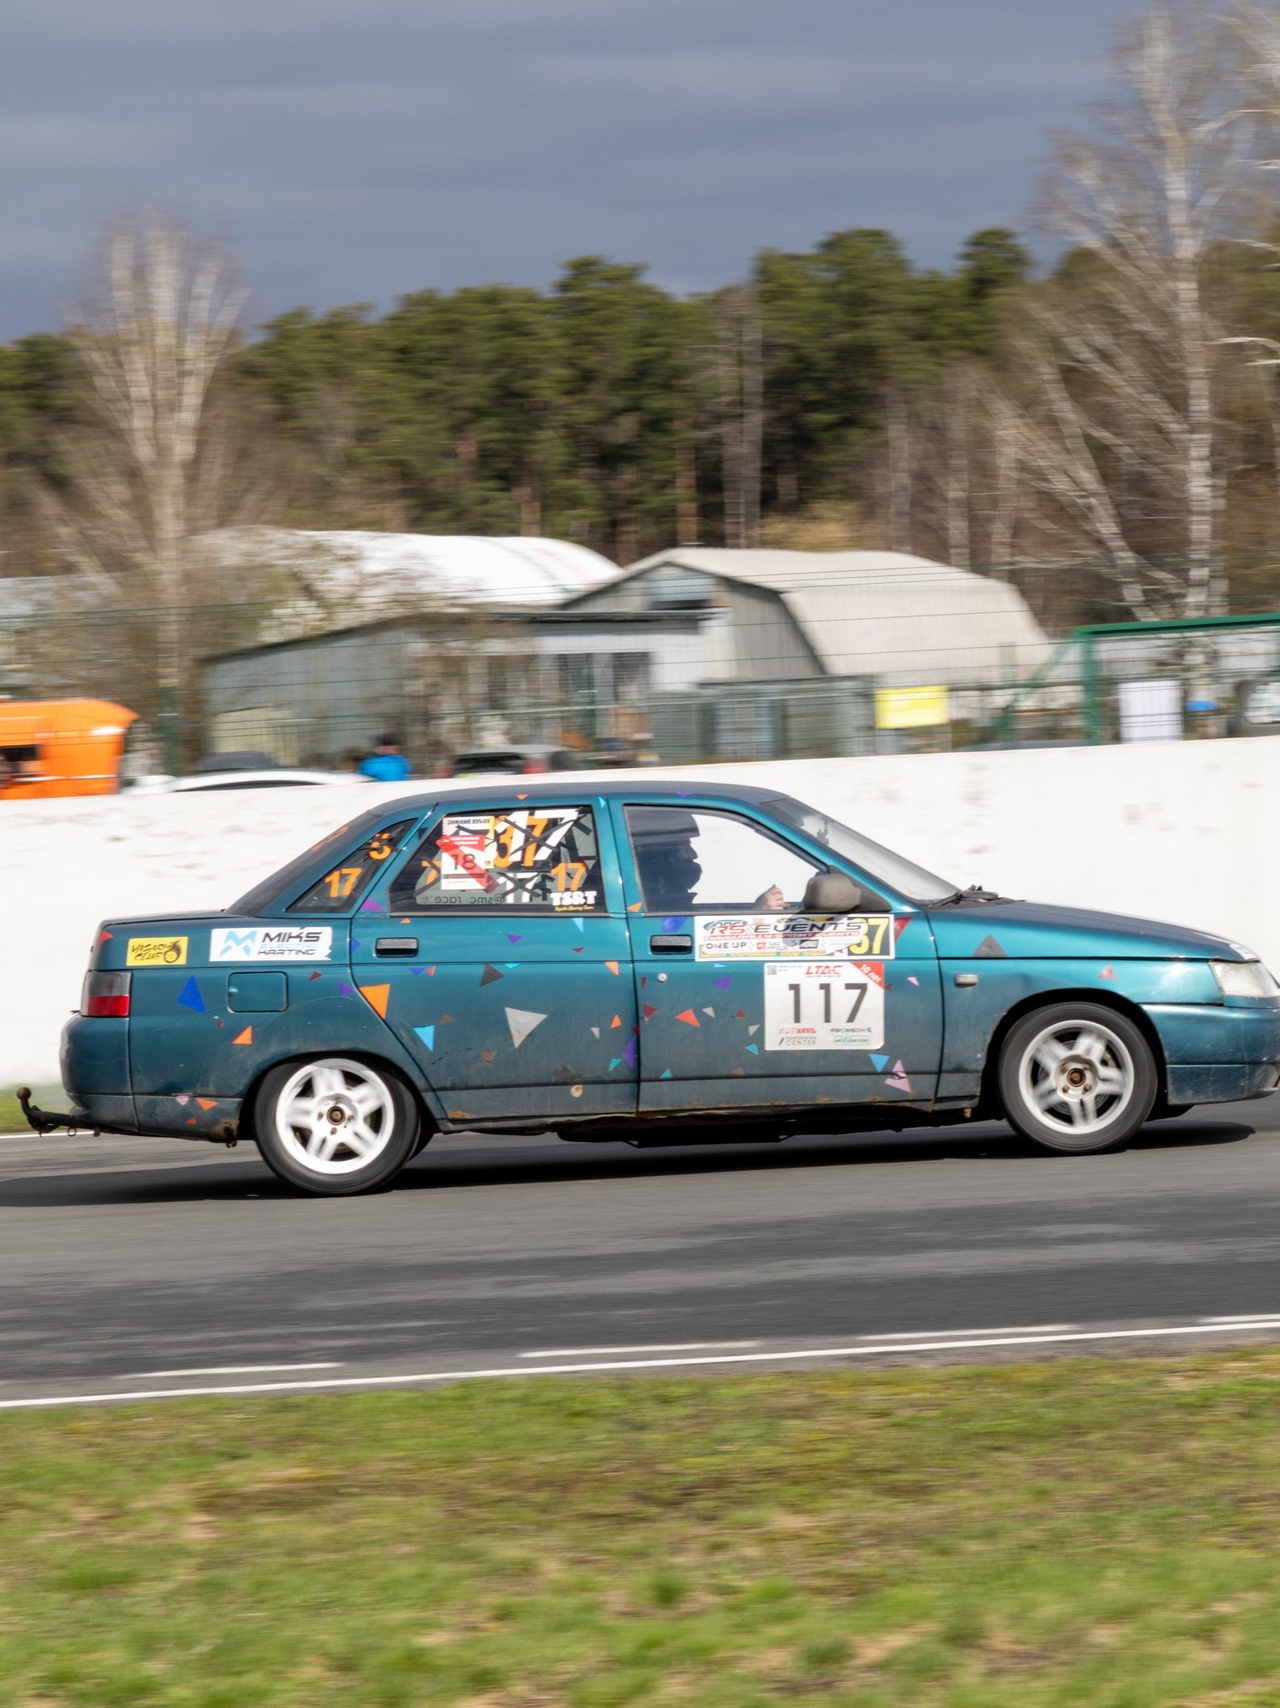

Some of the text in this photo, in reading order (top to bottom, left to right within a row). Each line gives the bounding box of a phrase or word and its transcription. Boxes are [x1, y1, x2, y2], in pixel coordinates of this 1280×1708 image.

[495, 809, 578, 861] 17
[450, 853, 476, 871] 18
[324, 867, 362, 898] 17
[550, 862, 587, 892] 17
[550, 890, 598, 906] TSRT
[710, 925, 746, 935] RS
[755, 920, 862, 933] EVENTS
[849, 917, 889, 955] 37
[262, 931, 323, 943] MIKS
[257, 948, 317, 956] KARTING
[805, 964, 843, 975] LTAC
[860, 963, 872, 974] 10
[788, 983, 868, 1024] 117
